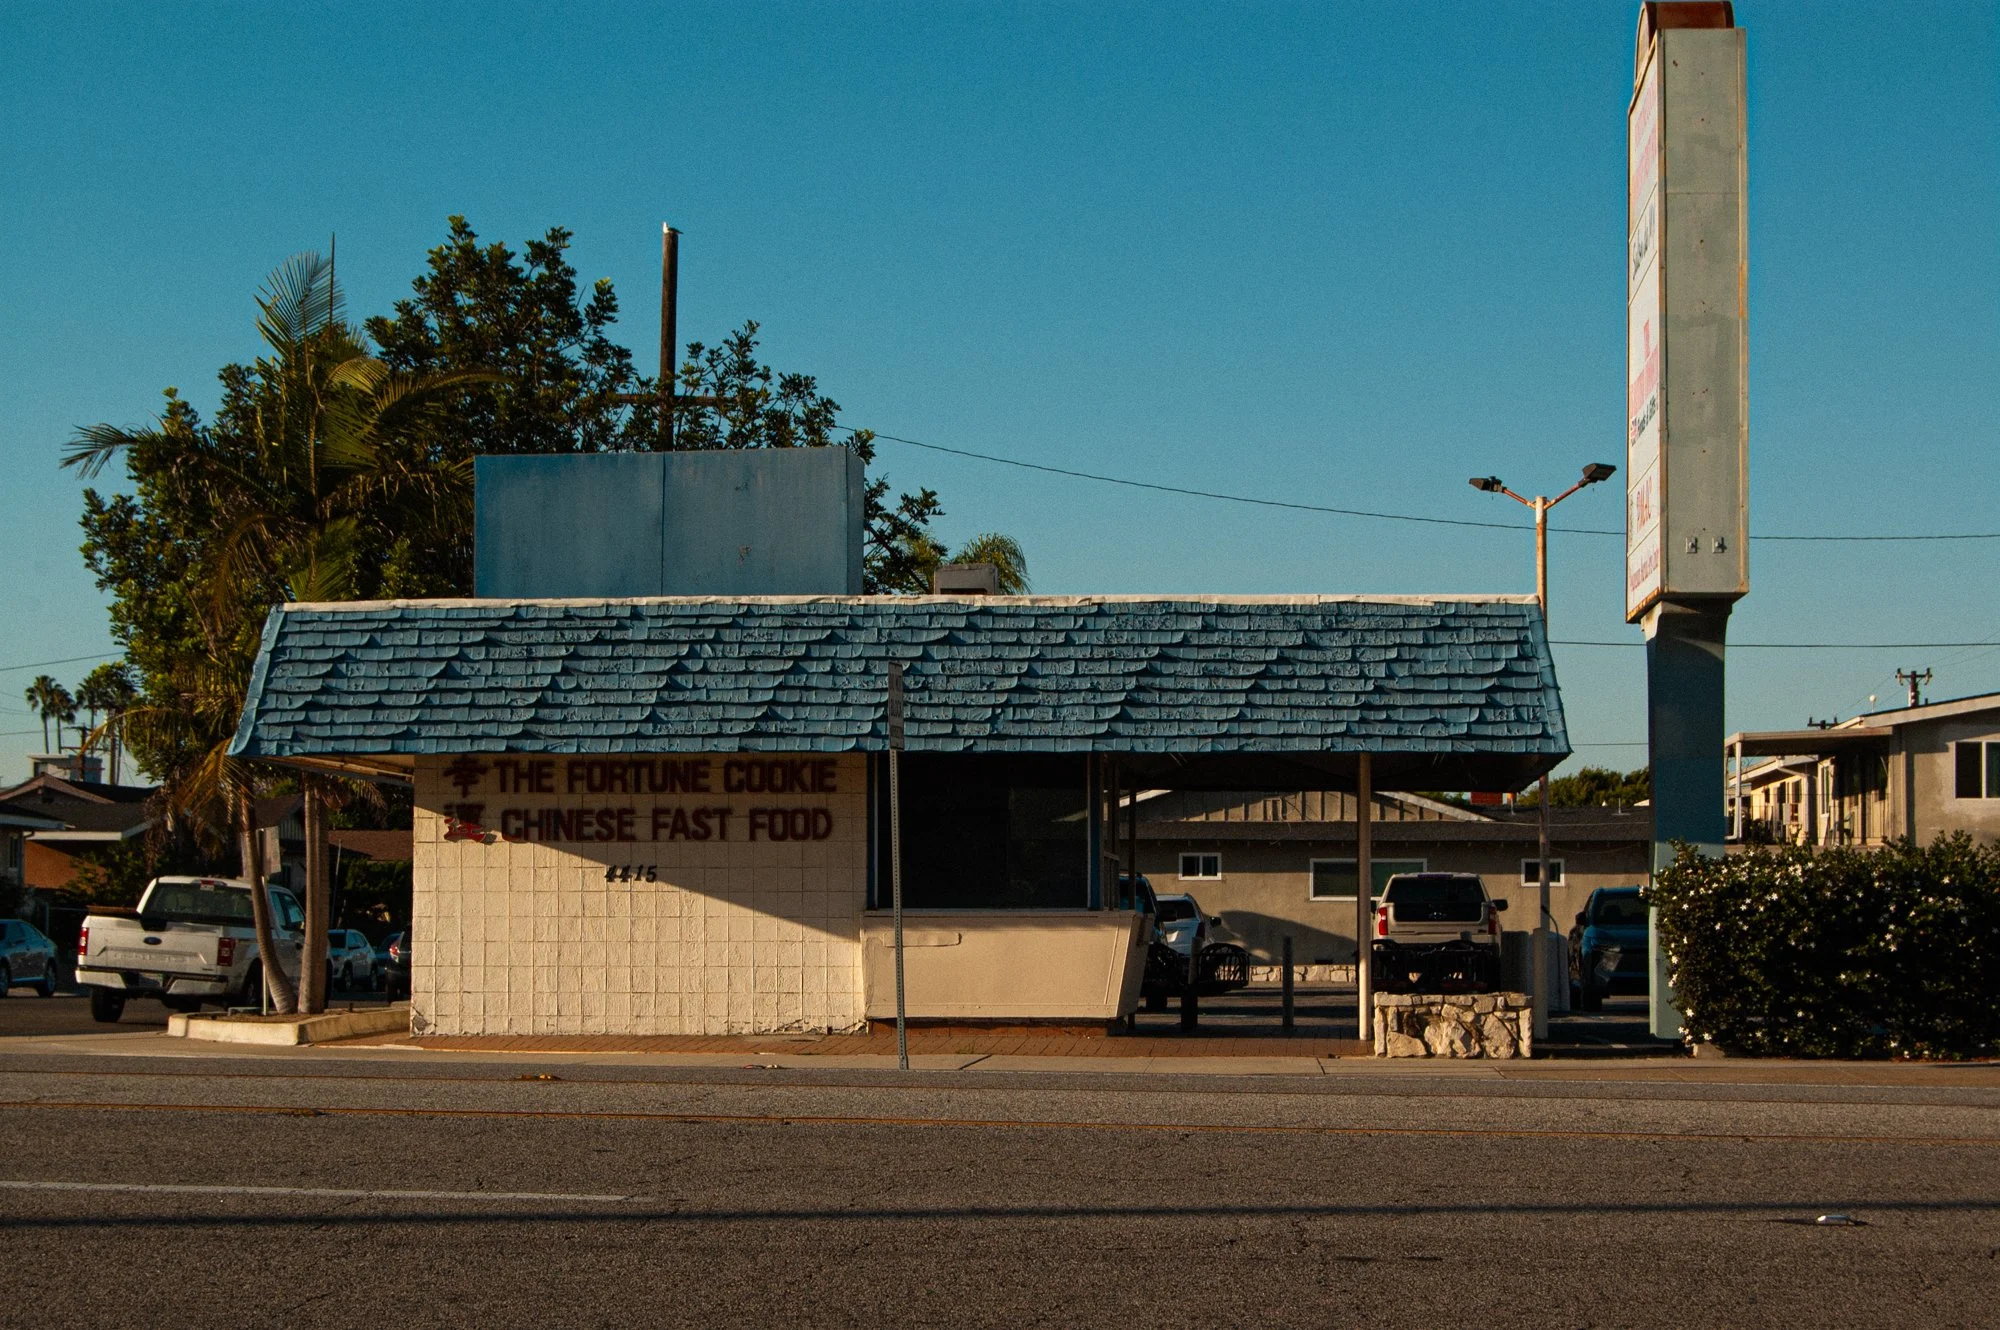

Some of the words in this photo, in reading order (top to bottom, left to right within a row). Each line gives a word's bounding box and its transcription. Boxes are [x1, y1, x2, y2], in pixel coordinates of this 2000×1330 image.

[494, 760, 555, 793] THE
[567, 760, 711, 793] FORTUNE
[724, 760, 838, 793] COOKIE
[501, 808, 637, 843] CHINESE
[651, 808, 734, 842] FAST
[749, 808, 834, 842] FOOD
[604, 864, 657, 883] 4415
